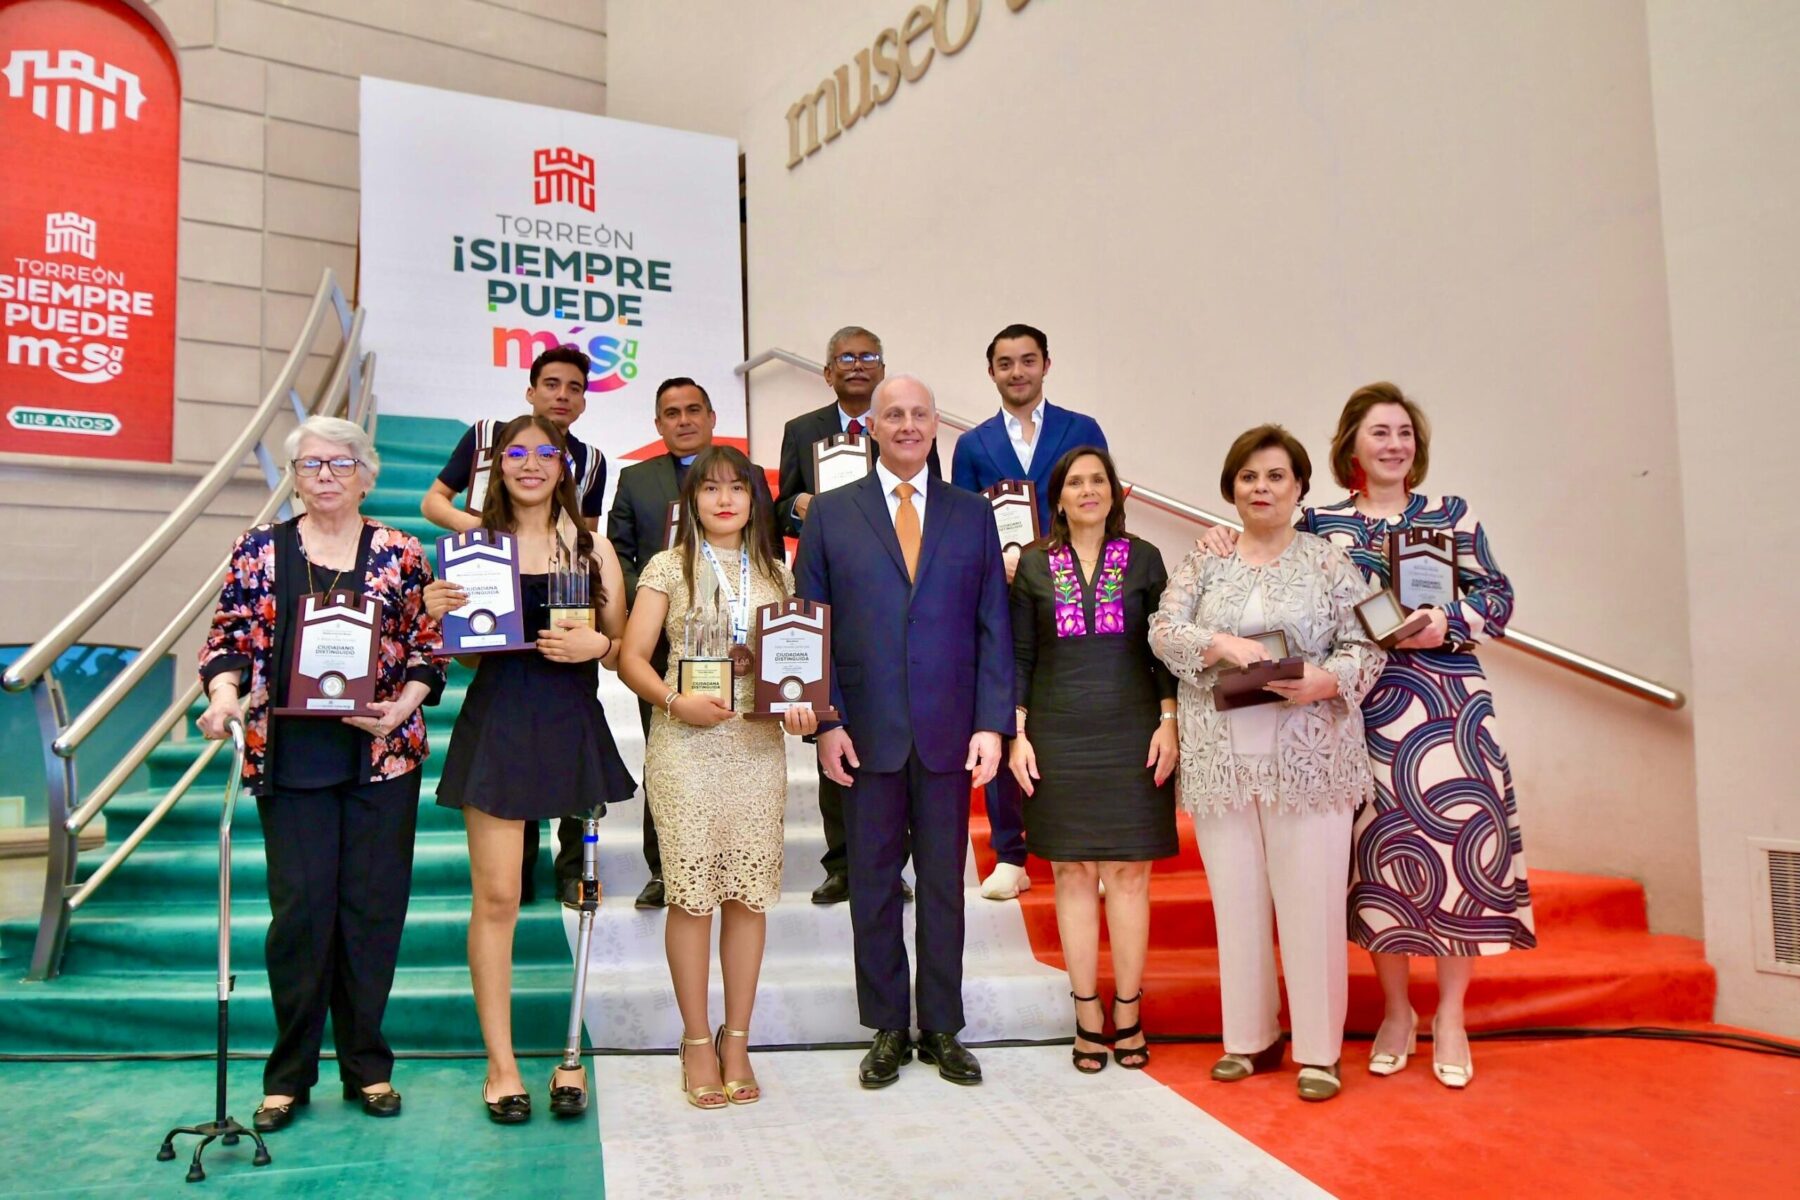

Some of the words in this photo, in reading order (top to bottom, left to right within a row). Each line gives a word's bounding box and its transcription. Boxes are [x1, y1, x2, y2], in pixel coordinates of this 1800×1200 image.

[785, 0, 982, 170] museo
[496, 214, 633, 250] TORREÓN
[14, 257, 124, 286] TORREÓN
[453, 236, 672, 292] ¡SIEMPRE
[5, 302, 129, 339] PUEDE
[487, 279, 642, 326] PUEDE
[22, 413, 47, 425] 118
[52, 415, 106, 430] AÑOS
